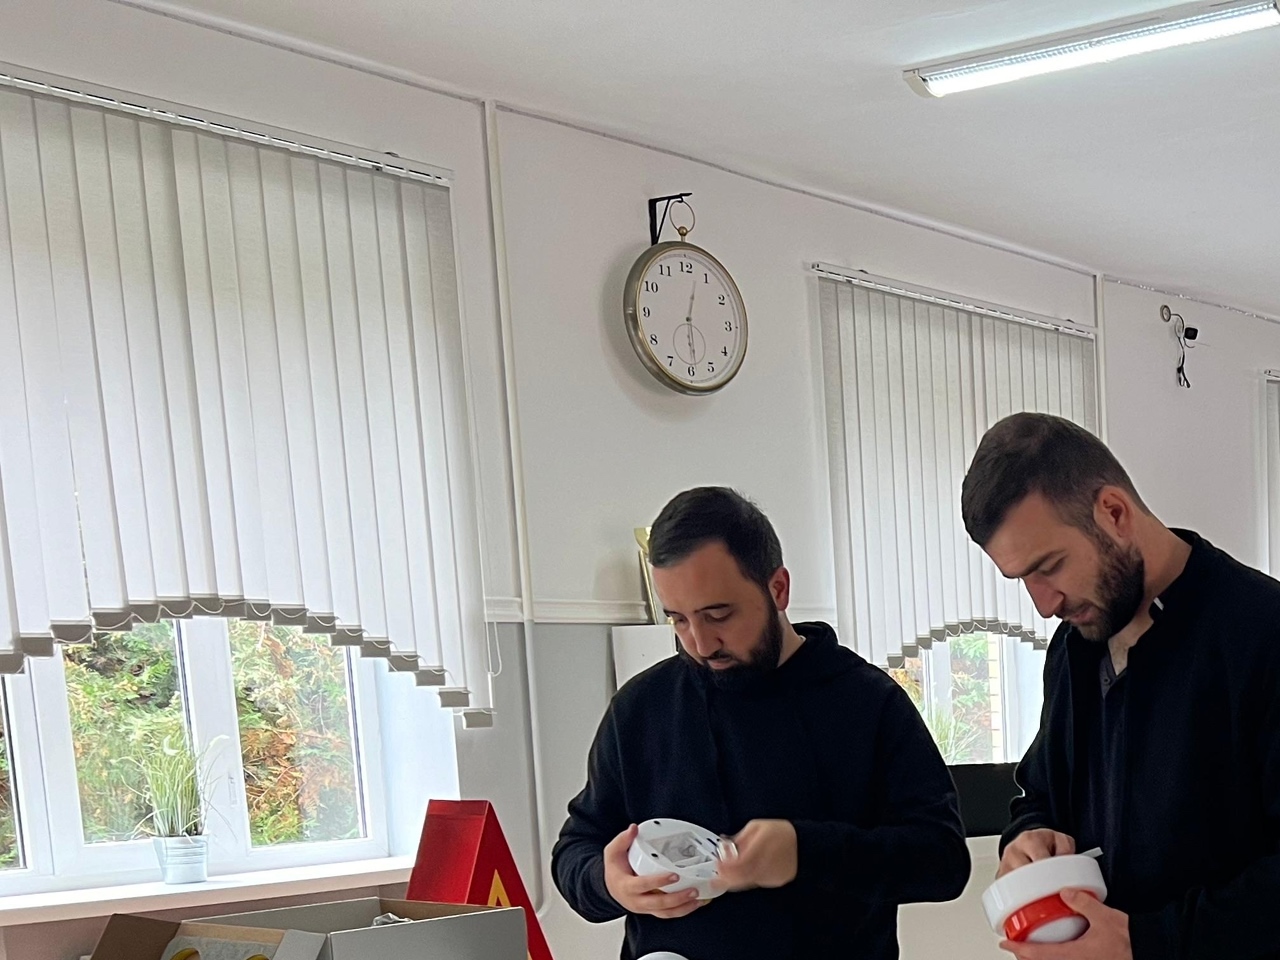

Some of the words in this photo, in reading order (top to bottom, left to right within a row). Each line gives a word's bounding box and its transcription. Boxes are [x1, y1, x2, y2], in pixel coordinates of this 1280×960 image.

[658, 264, 672, 277] 11
[679, 261, 693, 274] 12
[703, 273, 710, 284] 1
[644, 280, 659, 294] 10
[718, 294, 726, 306] 2
[642, 306, 650, 318] 9
[724, 320, 732, 332] 3
[650, 334, 658, 346] 8
[720, 346, 728, 357] 4
[666, 355, 674, 367] 7
[708, 362, 715, 372] 5
[688, 366, 695, 377] 6
